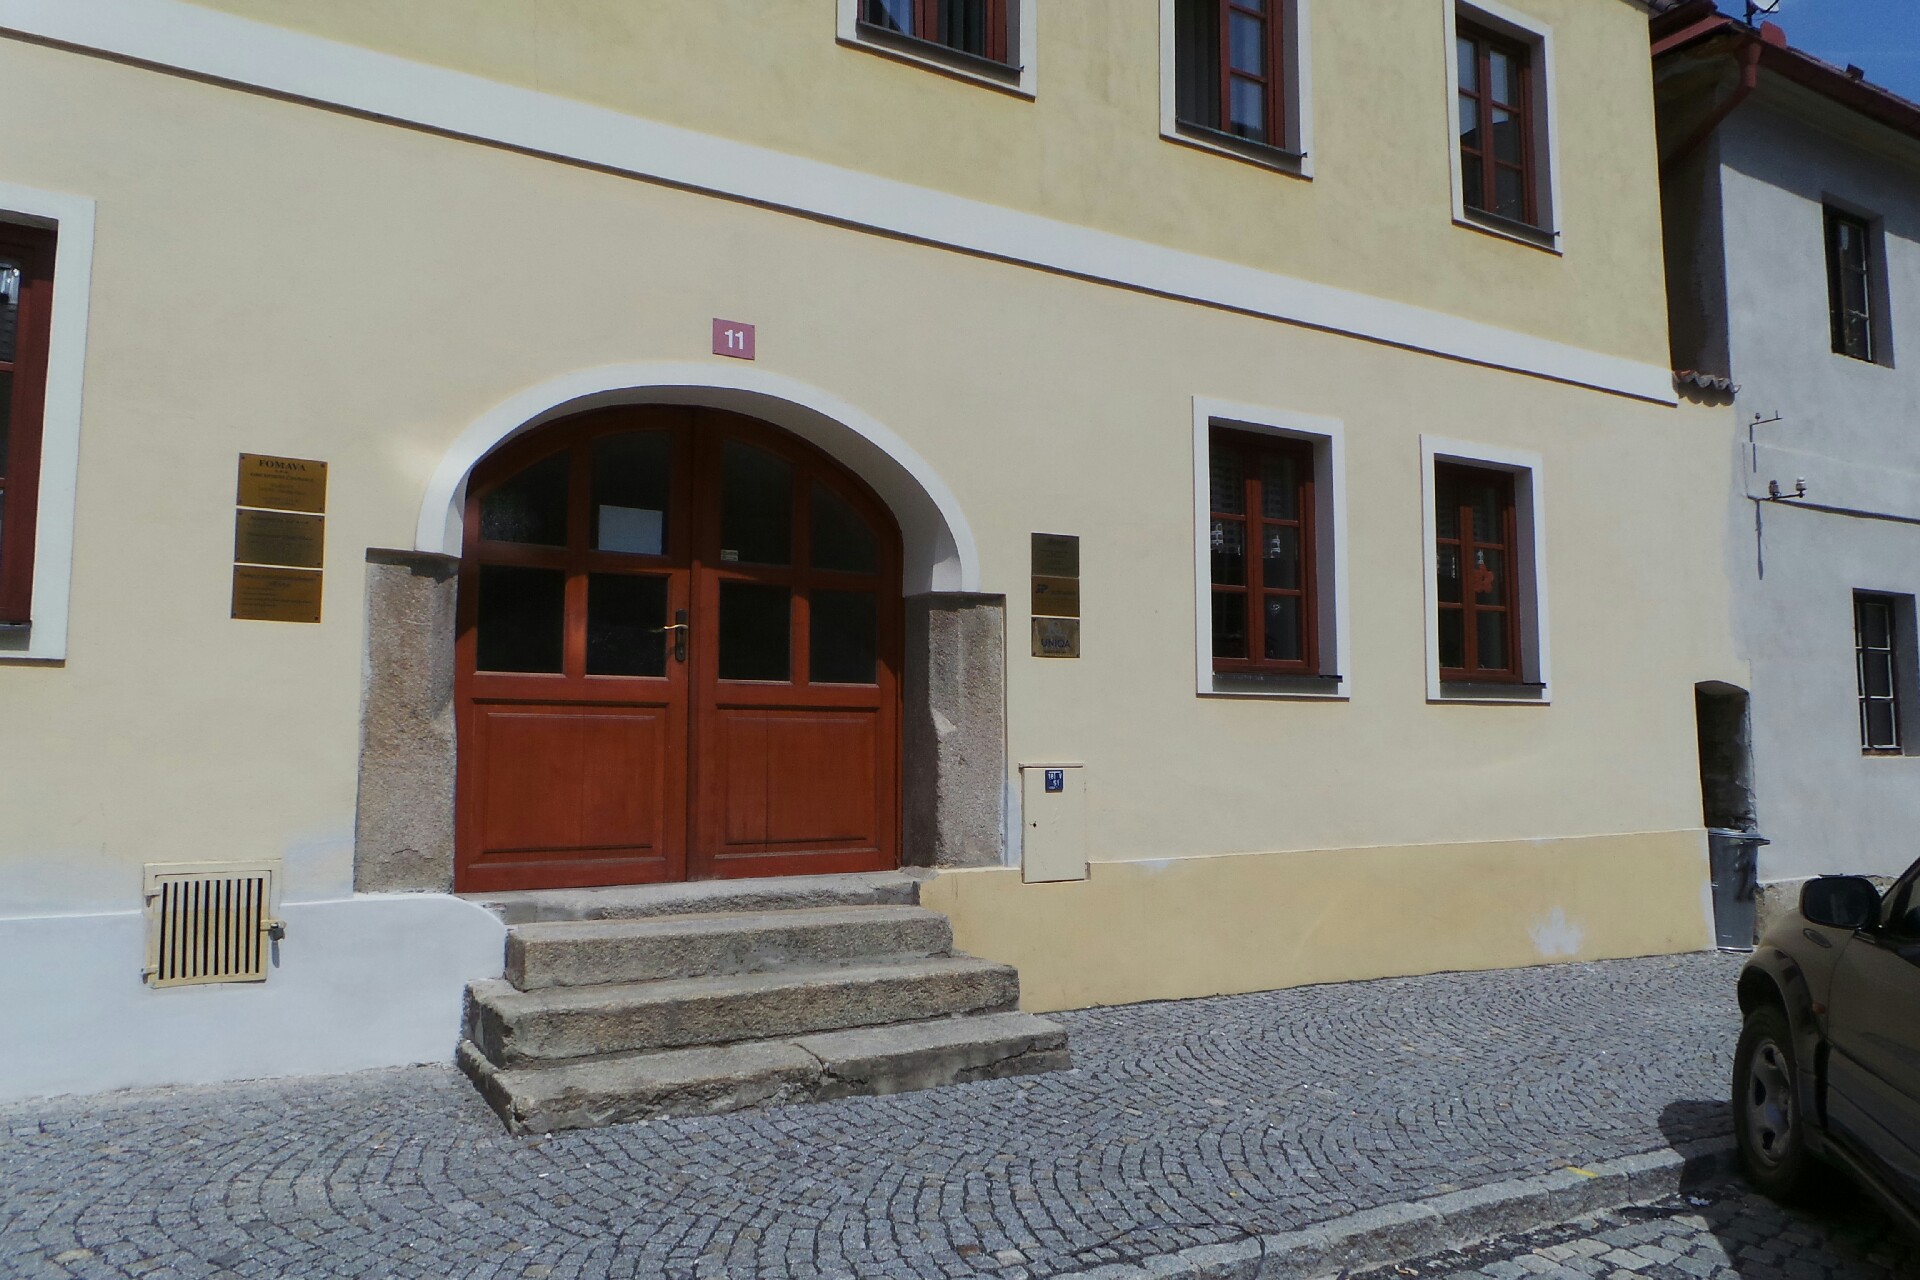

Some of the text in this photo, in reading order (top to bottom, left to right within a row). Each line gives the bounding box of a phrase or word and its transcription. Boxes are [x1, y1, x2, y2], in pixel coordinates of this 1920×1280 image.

[724, 329, 744, 350] 11
[258, 459, 306, 472] FOMAVA
[1041, 638, 1071, 648] UNIQA
